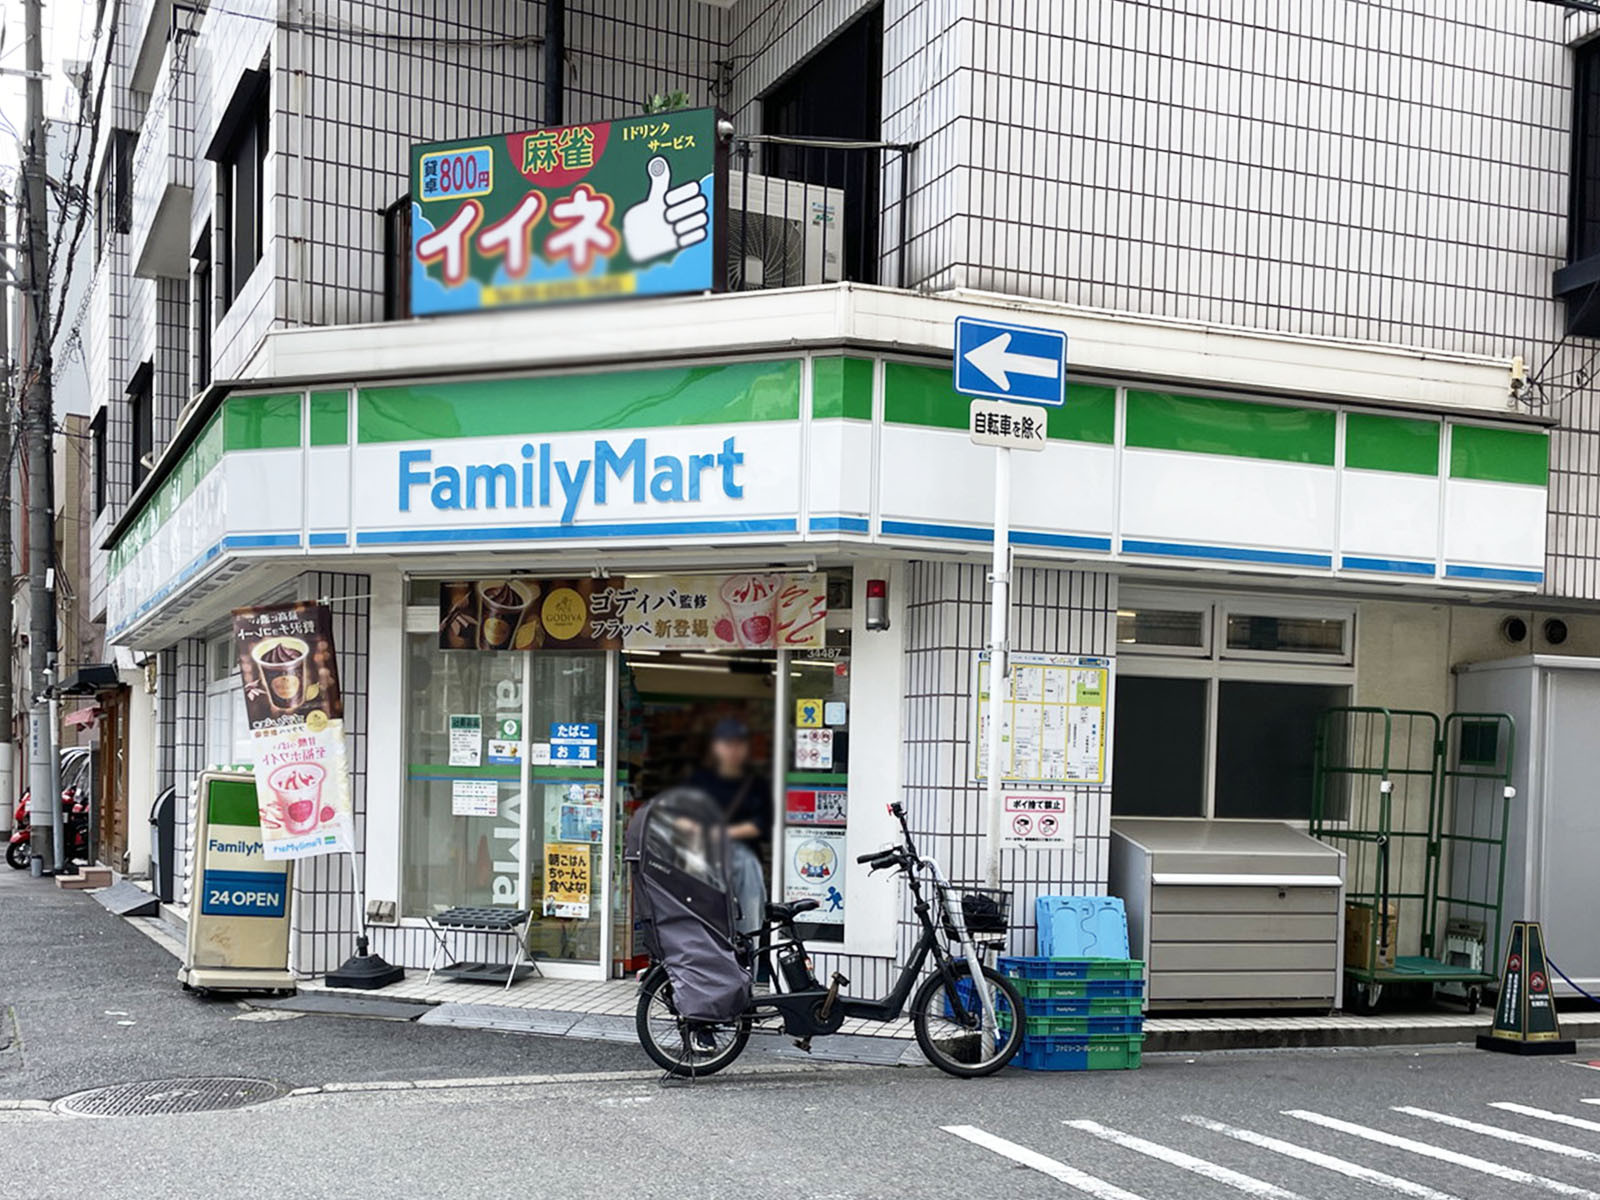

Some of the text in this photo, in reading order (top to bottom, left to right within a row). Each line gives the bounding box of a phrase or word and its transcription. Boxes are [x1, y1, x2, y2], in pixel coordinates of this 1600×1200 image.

[522, 127, 595, 174] 麻雀
[647, 135, 696, 153] サービス
[424, 160, 438, 193] 貸卓
[440, 155, 490, 193] 800円
[416, 183, 620, 286] イイネ
[975, 411, 1043, 440] 自転車を除く
[399, 436, 745, 527] FamilyMart
[590, 586, 708, 618] ゴディバ監修
[546, 614, 583, 622] GODIVA
[807, 648, 842, 658] 34487
[557, 724, 590, 737] たばこ
[556, 745, 590, 758] お酒
[1013, 800, 1062, 810] ポイ捨て禁止
[548, 853, 587, 866] 朝ごはん
[548, 867, 587, 880] ちゃーんと
